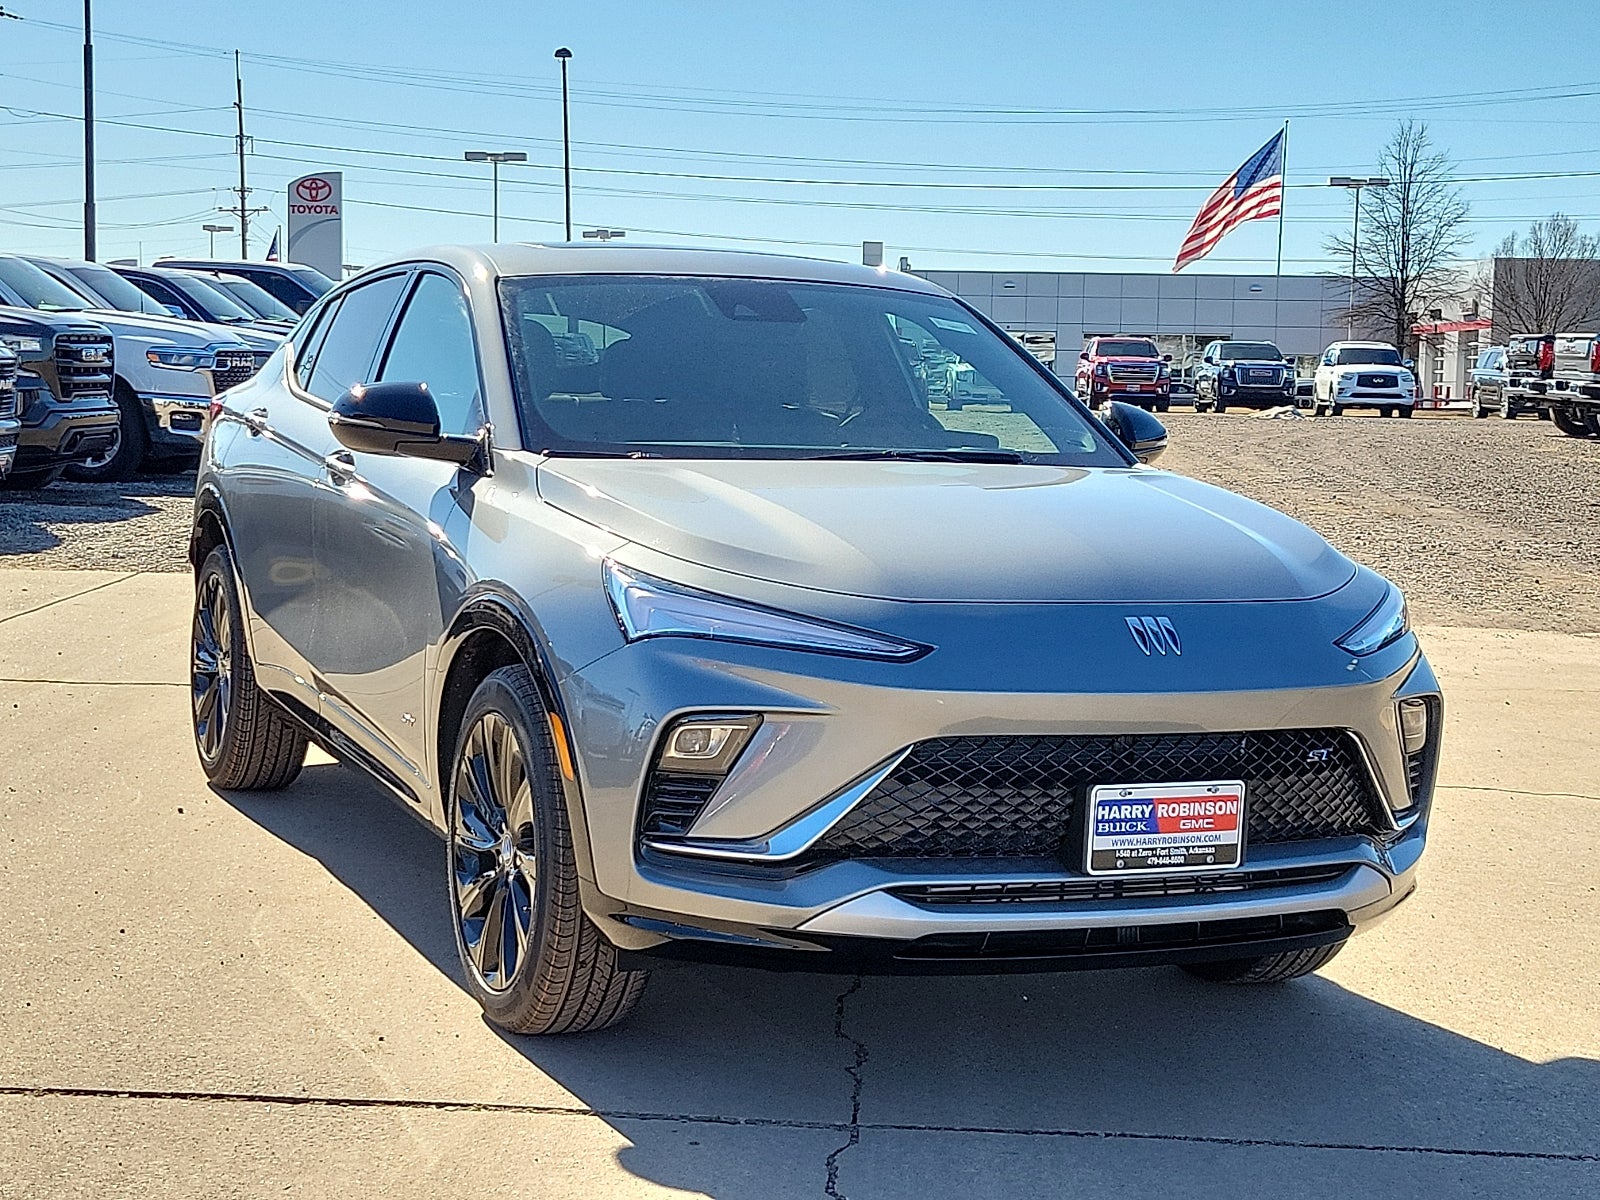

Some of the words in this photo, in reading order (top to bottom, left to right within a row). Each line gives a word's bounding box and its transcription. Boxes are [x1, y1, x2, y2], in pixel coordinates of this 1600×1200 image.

[290, 204, 338, 214] TOYOTA
[1307, 747, 1333, 762] ST
[1097, 804, 1154, 820] HARRY
[1157, 800, 1237, 818] ROBINSON
[1097, 820, 1149, 833] BUICK
[1179, 818, 1215, 829] GMC
[1111, 833, 1221, 847] WWW.HARRYROBINSON.COM
[1138, 849, 1152, 857] Zero
[1156, 848, 1169, 856] Fort
[1170, 847, 1188, 856] Smith,
[1189, 846, 1216, 855] Arkansas
